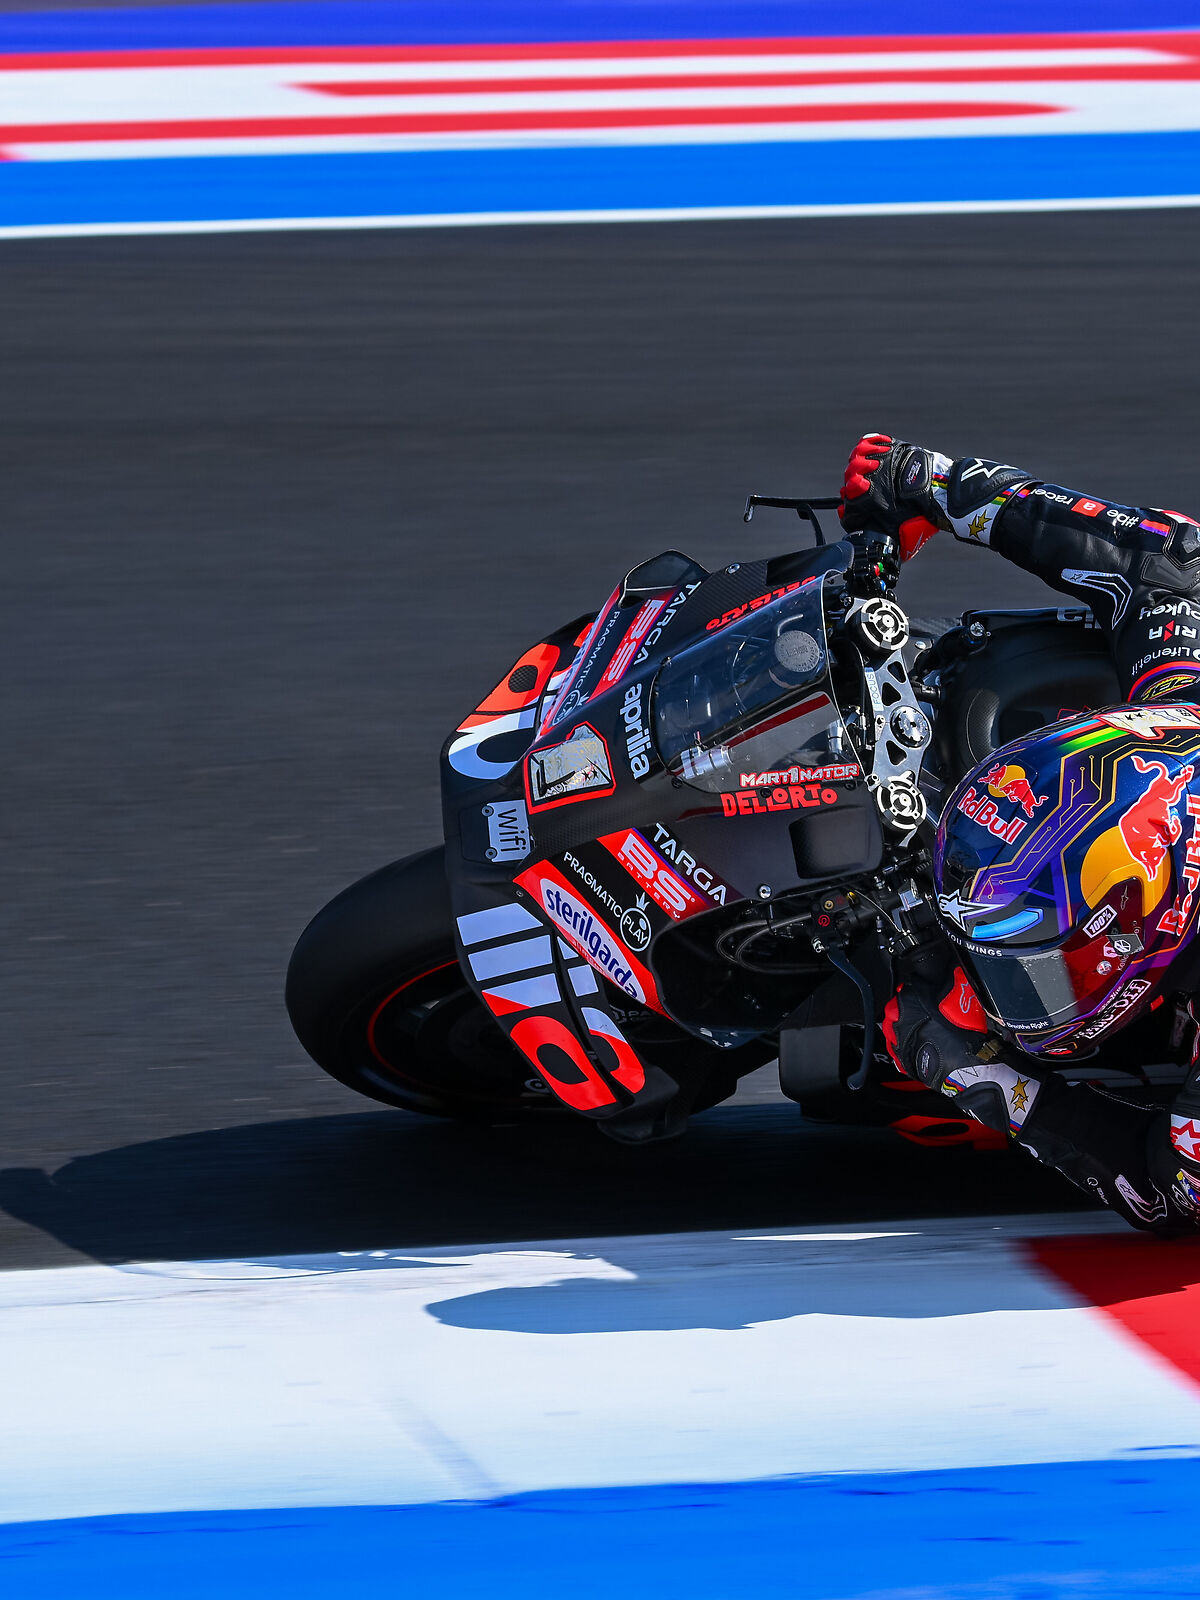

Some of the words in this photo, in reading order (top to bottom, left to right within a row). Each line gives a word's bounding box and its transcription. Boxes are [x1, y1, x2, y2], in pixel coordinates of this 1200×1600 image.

[575, 611, 620, 689] PRAGMATIC
[608, 599, 665, 682] BS
[633, 581, 701, 665] TARGA
[866, 673, 881, 705] FOCUS
[1132, 646, 1190, 677] Lifenet.it
[620, 683, 652, 780] aprilia
[498, 809, 527, 852] wifi
[974, 800, 1028, 845] Bull
[563, 851, 623, 918] PRAGMATIC
[620, 833, 692, 911] BS
[653, 822, 727, 906] TARGA
[545, 888, 638, 999] sterilgarda
[623, 915, 648, 945] PLAY
[965, 942, 1002, 956] WINGS
[1088, 909, 1112, 935] 100%
